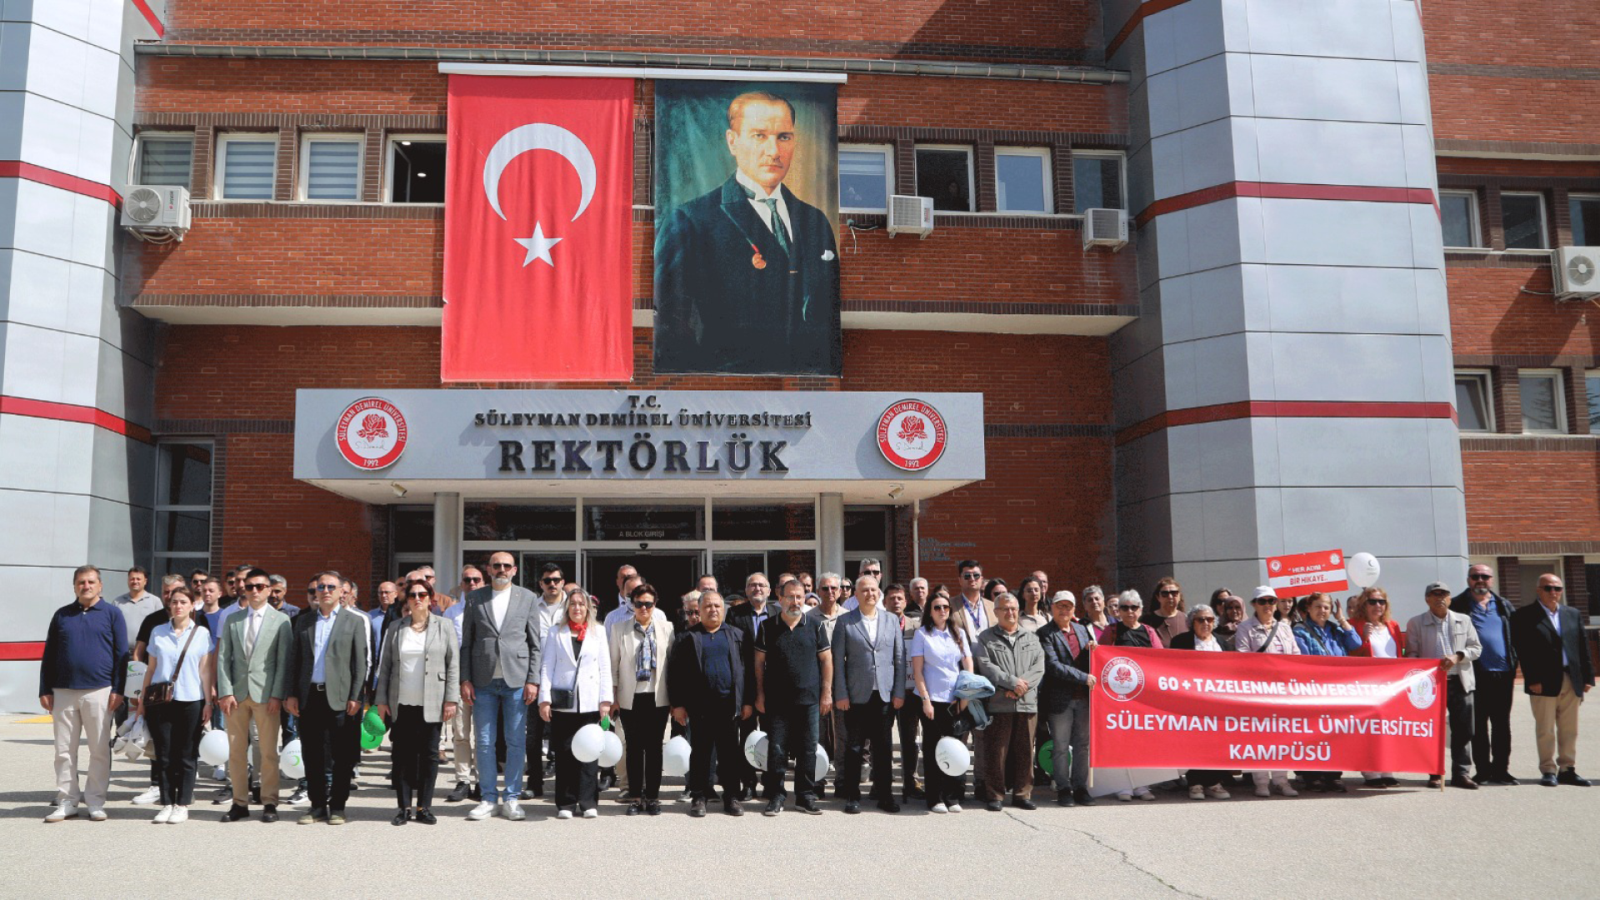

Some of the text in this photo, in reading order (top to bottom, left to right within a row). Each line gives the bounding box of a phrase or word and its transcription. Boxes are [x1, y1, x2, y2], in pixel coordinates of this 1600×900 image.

[628, 395, 661, 408] T.C.
[474, 408, 812, 427] SÜLEYMAN DEMİREL ÜNİVERSİTESİ
[498, 432, 789, 472] REKTÖRLÜK
[363, 459, 379, 467] 1992
[904, 460, 920, 468] 1992
[1193, 678, 1287, 695] TAZELENME
[1106, 710, 1434, 737] SÜLEYMAN DEMİREL ÜNİVERSİTESİ
[1229, 741, 1331, 761] KAMPÜSÜ
